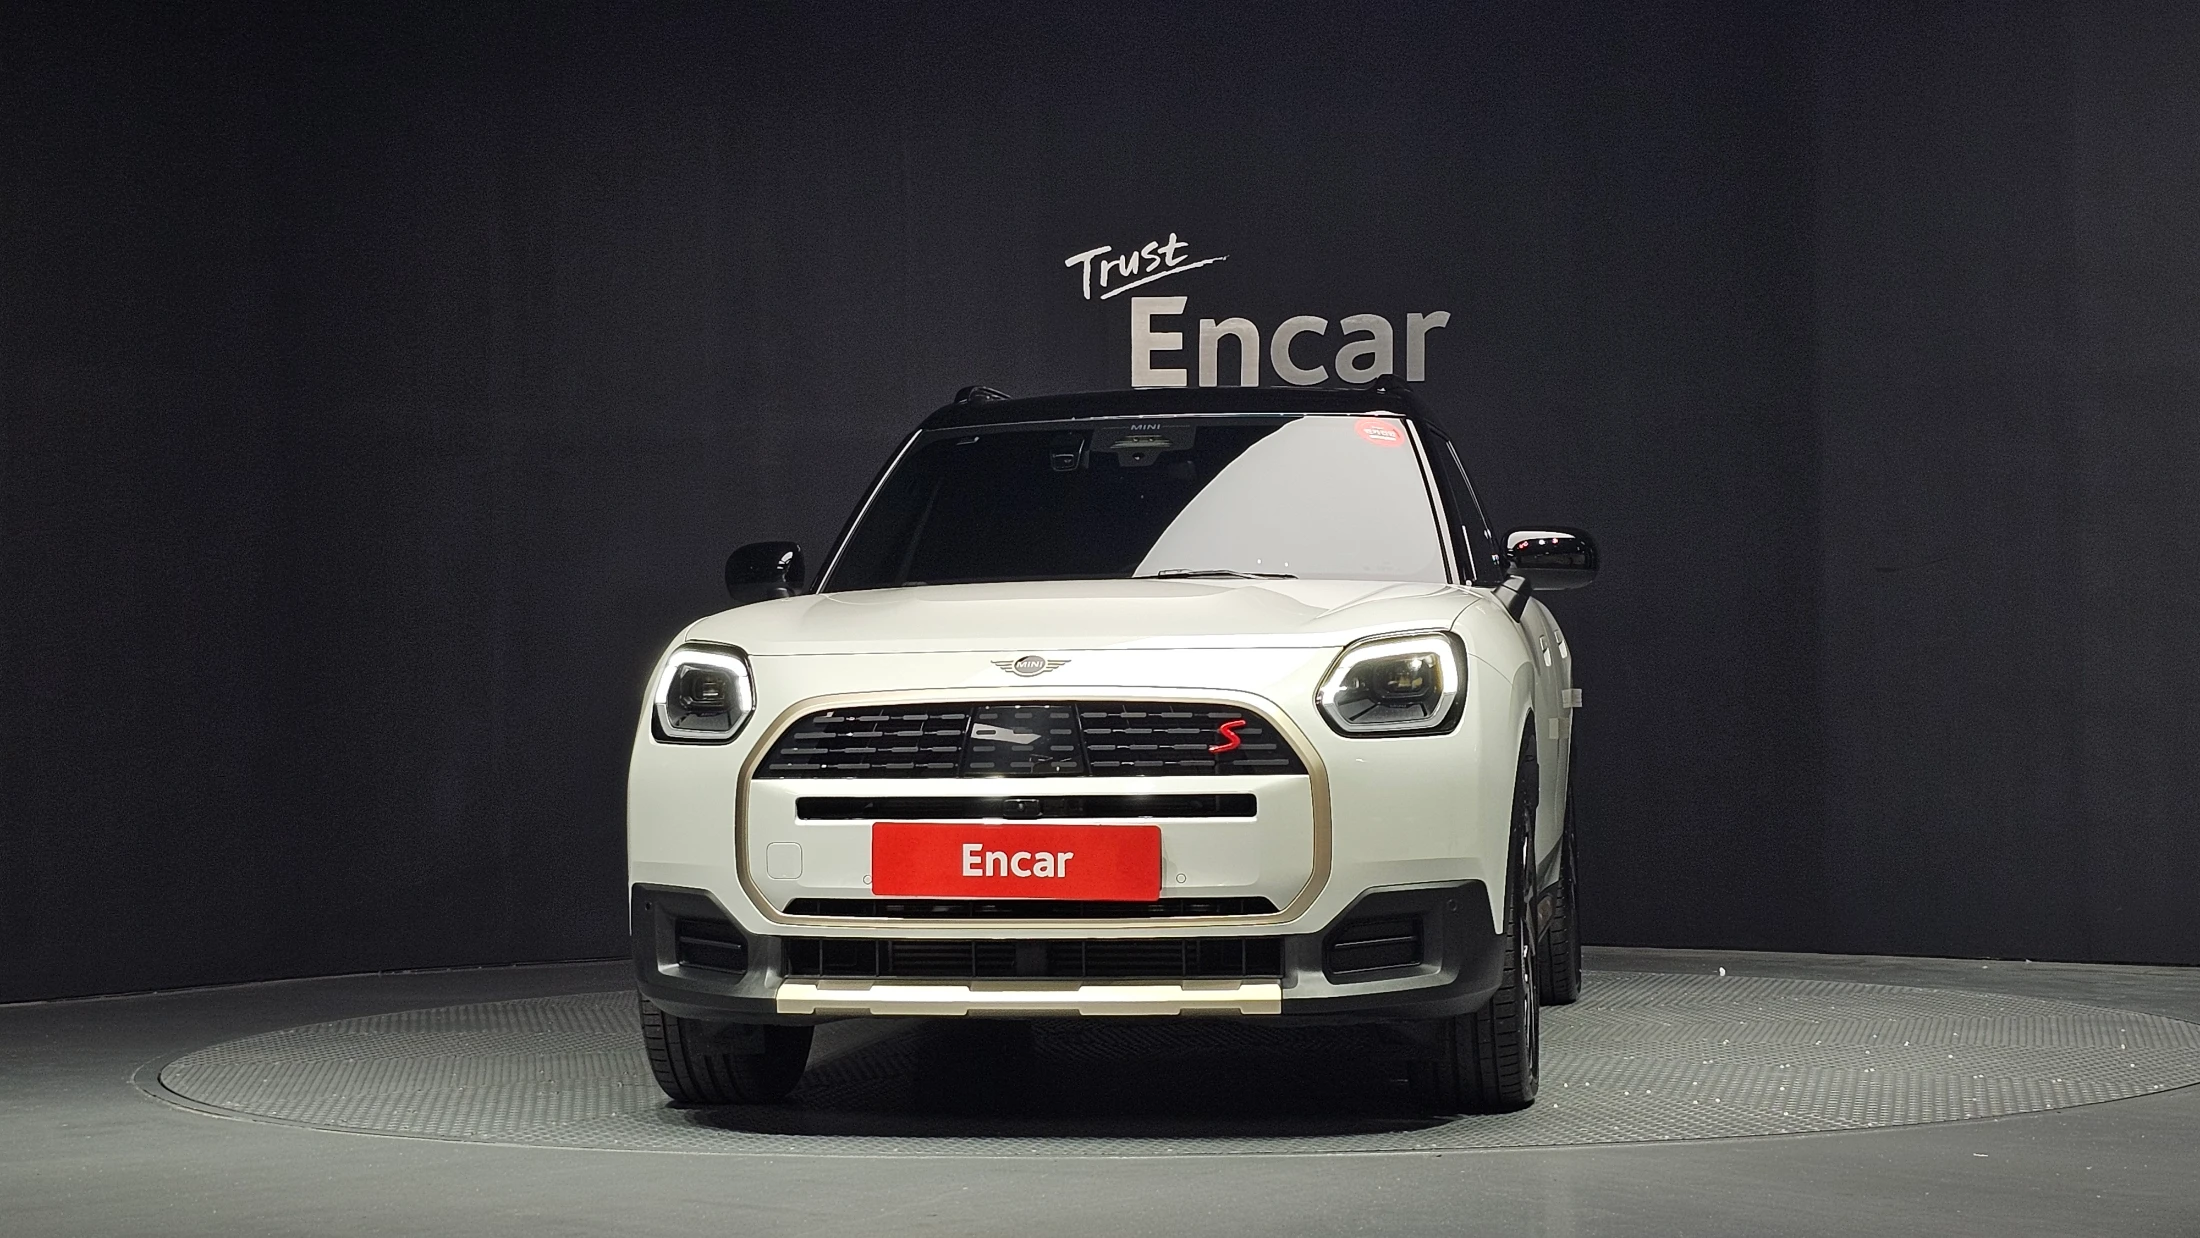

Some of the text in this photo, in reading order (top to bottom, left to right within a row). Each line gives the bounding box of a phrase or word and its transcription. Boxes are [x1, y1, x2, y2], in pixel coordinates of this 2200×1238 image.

[1065, 232, 1190, 300] Trust
[1130, 296, 1452, 387] Encar
[1130, 423, 1161, 431] MINI
[1016, 660, 1044, 669] MINI
[1209, 719, 1246, 752] S
[961, 842, 1074, 879] Encar
